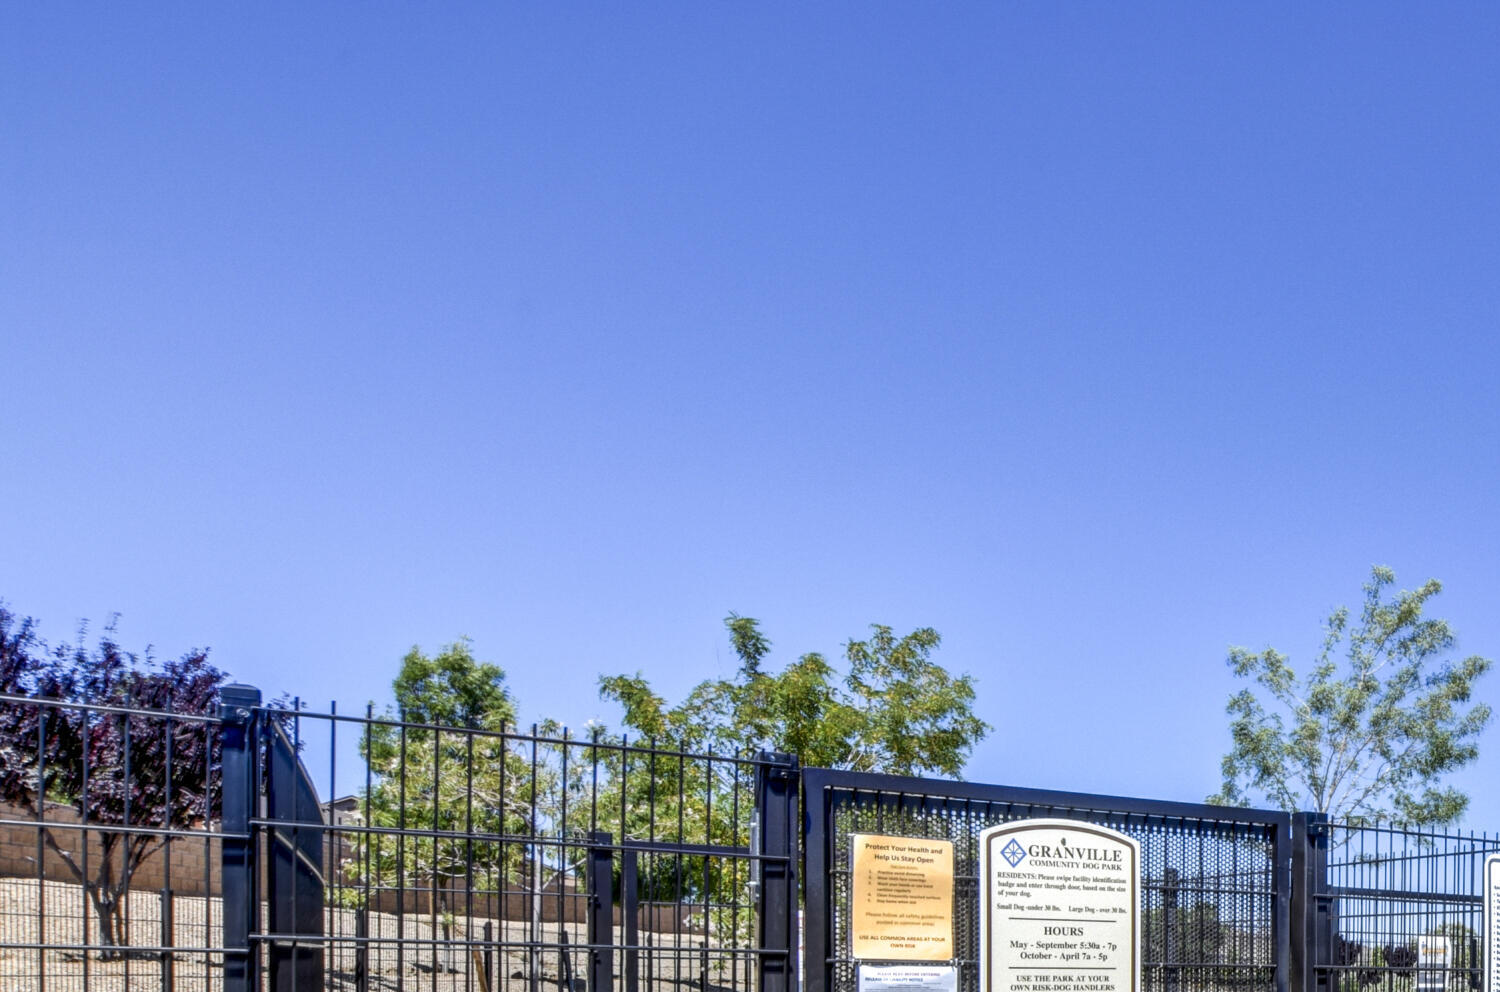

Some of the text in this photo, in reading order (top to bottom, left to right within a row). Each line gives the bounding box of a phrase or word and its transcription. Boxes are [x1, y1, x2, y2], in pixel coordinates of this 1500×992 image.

[908, 846, 929, 854] Health
[1028, 844, 1122, 862] GRANVILLE
[1029, 859, 1122, 871] COMMUNITY DOG PARK
[997, 871, 1037, 880] RESIDENTS:
[1057, 875, 1071, 883] swipe
[1092, 876, 1127, 884] identification
[998, 881, 1015, 889] badge
[1045, 883, 1066, 891] through
[1019, 890, 1032, 898] dog.
[1013, 904, 1024, 912] Dog
[1068, 905, 1083, 913] Large
[1085, 906, 1095, 914] Dog
[1044, 926, 1084, 936] HOURS
[1010, 941, 1028, 949] May
[1036, 941, 1077, 950] September
[1108, 943, 1117, 951] 7p
[1020, 952, 1053, 960] October
[1059, 952, 1079, 961] April
[1098, 953, 1108, 962] 5p
